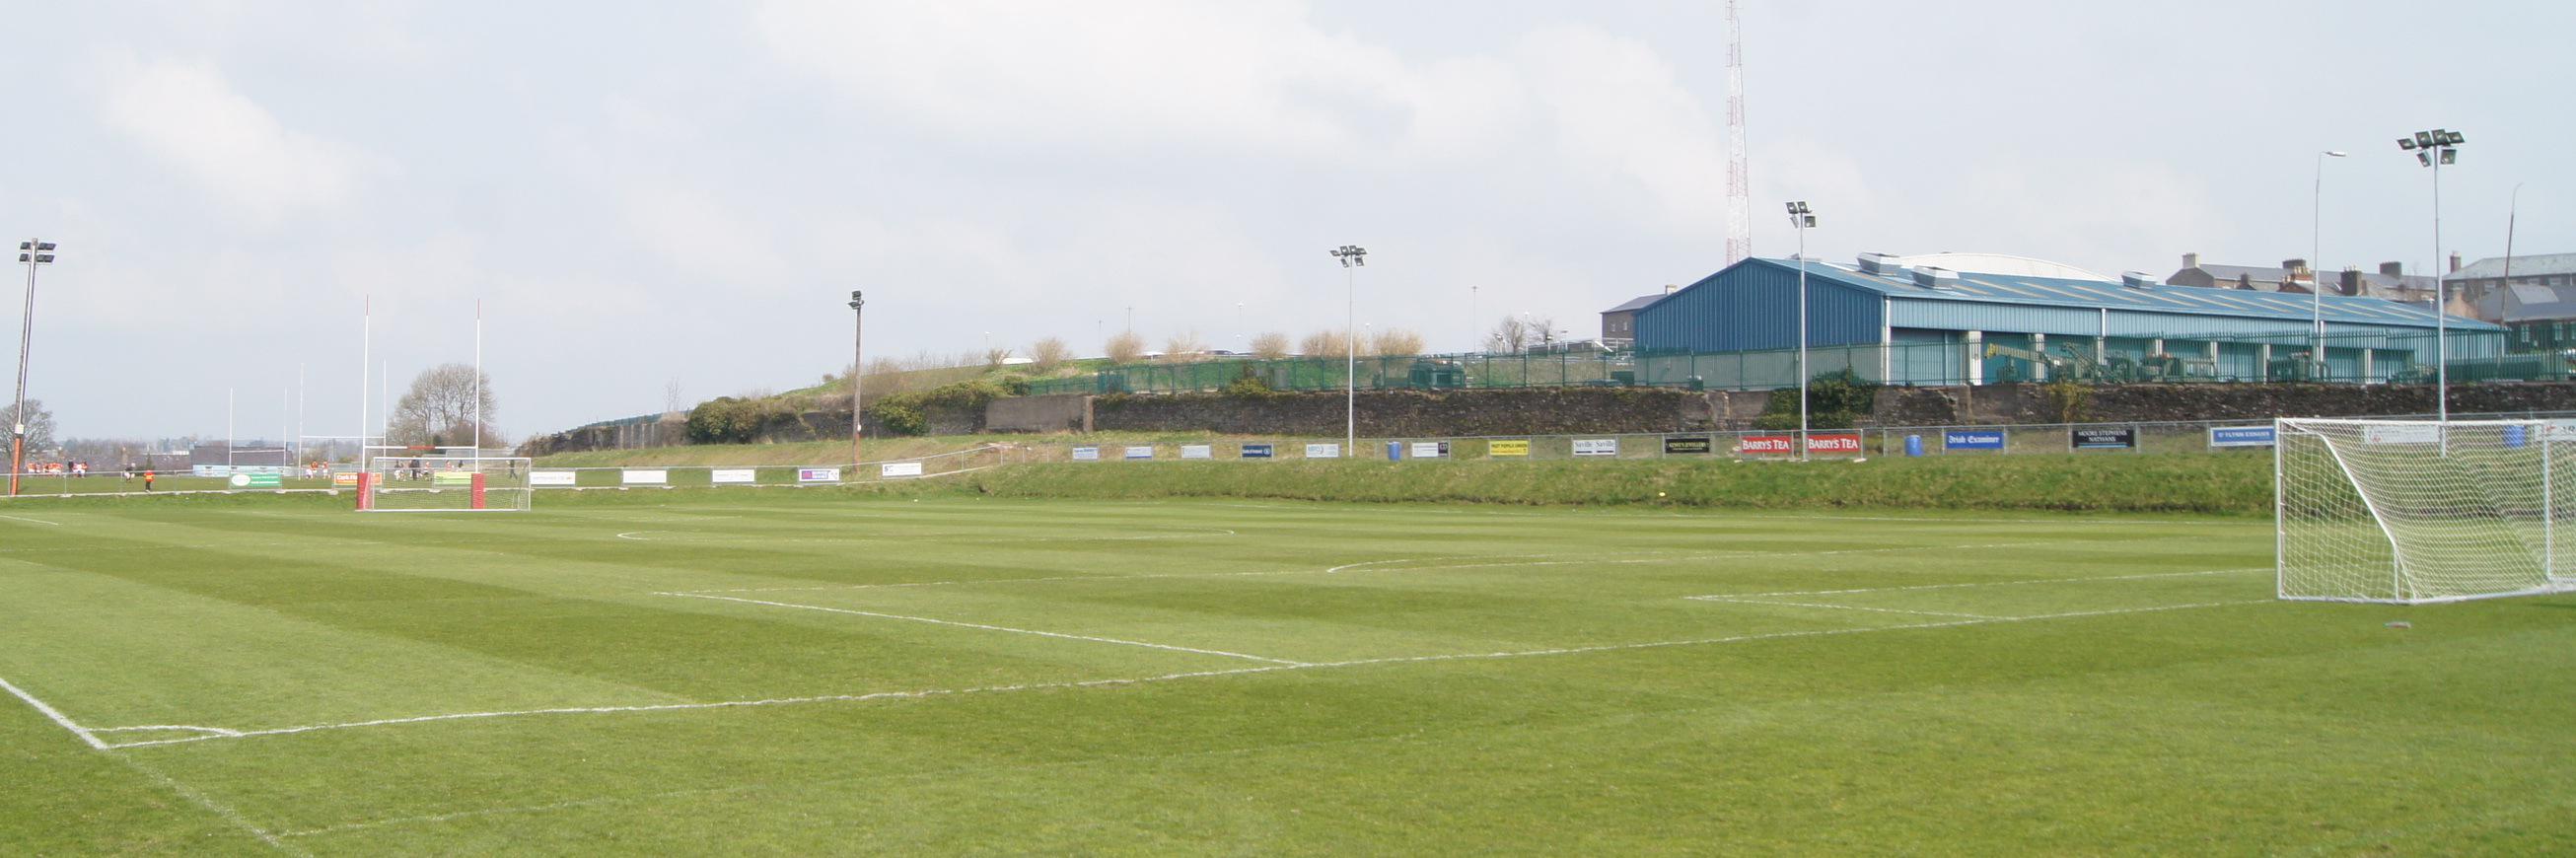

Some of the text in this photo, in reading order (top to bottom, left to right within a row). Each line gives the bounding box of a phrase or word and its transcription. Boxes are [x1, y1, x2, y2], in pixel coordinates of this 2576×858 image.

[1808, 438, 1858, 449] BARRY'S TEA
[1948, 435, 2000, 444] Irish Examiner
[1743, 440, 1789, 450] BARRY'S TEA
